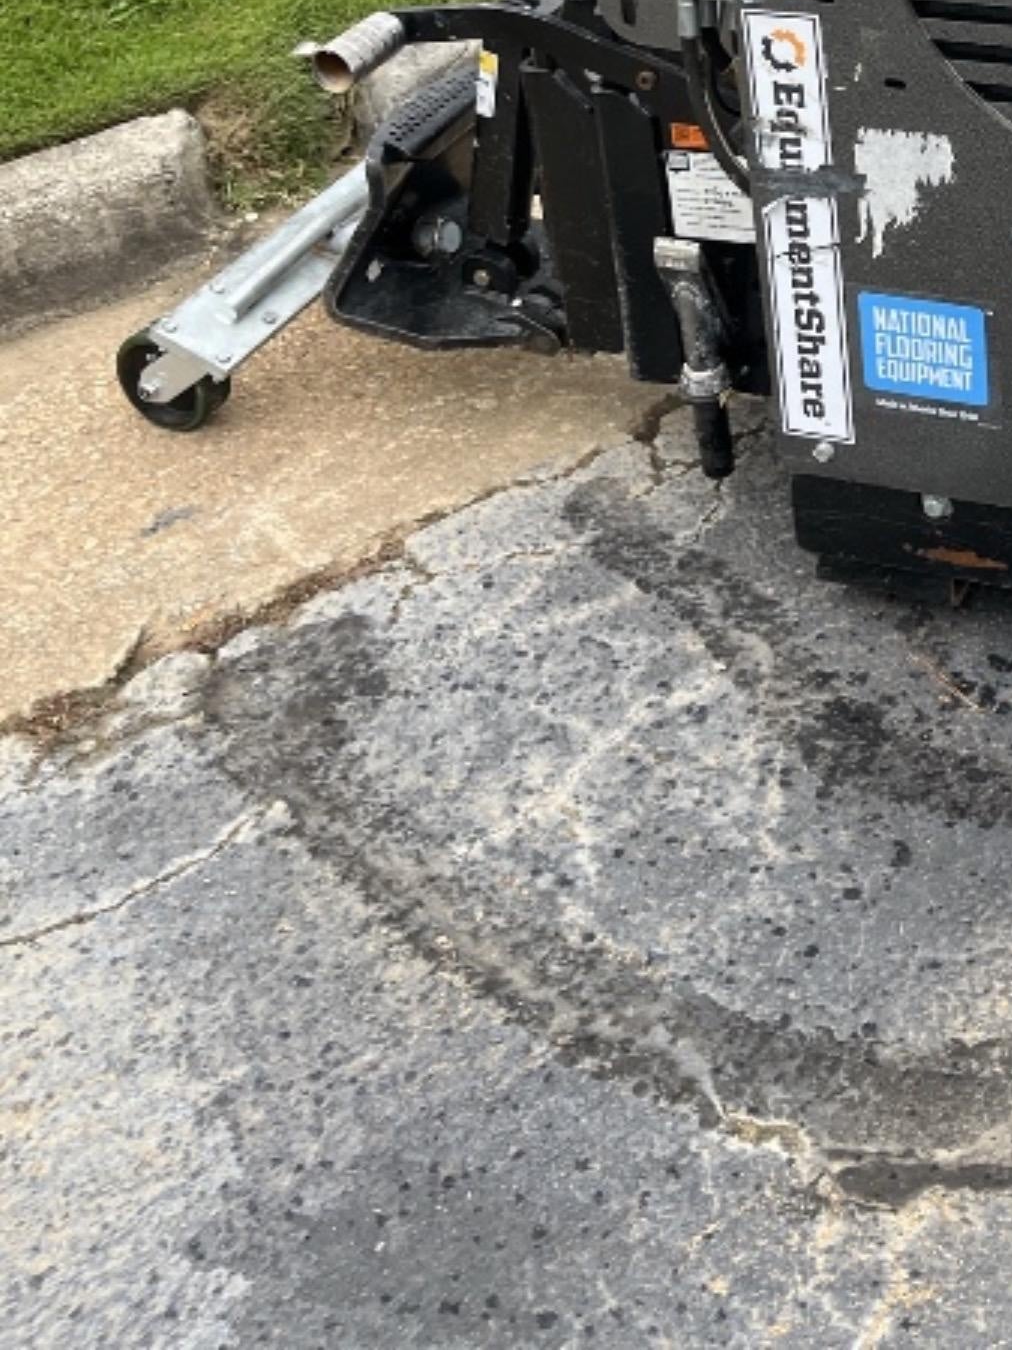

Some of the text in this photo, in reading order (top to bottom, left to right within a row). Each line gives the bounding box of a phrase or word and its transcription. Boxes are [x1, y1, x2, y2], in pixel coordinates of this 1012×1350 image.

[872, 305, 973, 344] NATIONAL
[875, 332, 974, 371] FLOORING
[877, 356, 974, 392] EQUIPMENT
